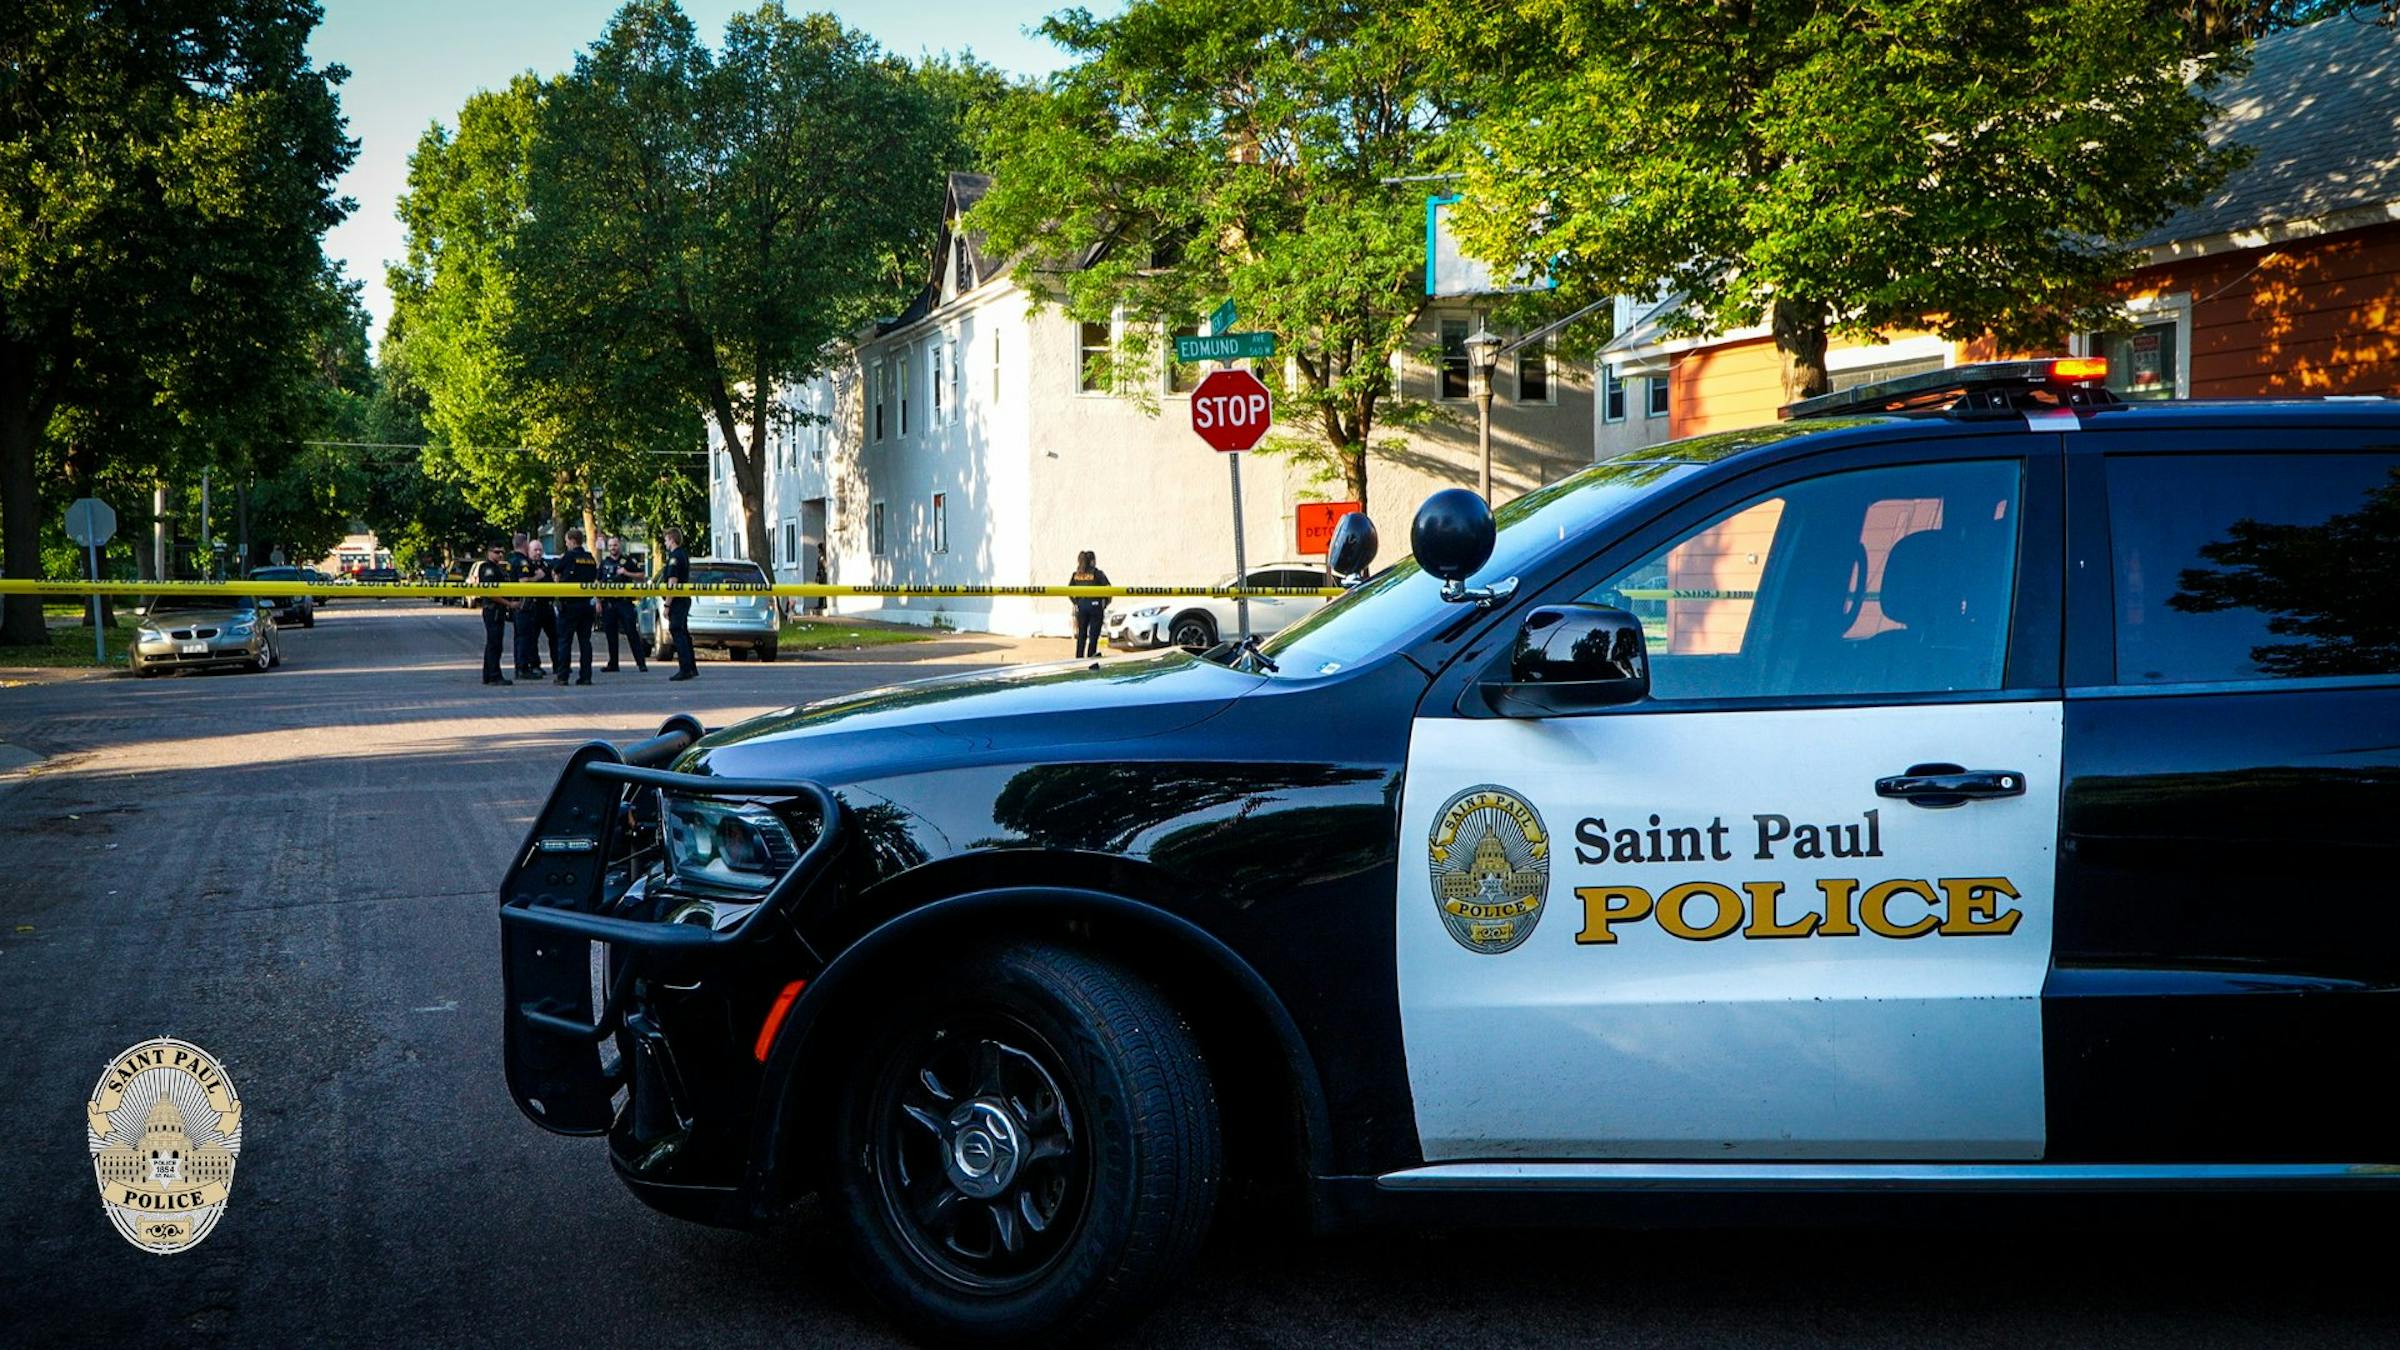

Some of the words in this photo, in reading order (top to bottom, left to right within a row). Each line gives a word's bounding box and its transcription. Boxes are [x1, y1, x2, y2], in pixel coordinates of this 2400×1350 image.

[1181, 339, 1239, 357] EDMUND
[1196, 394, 1266, 429] STOP
[1306, 527, 1335, 537] DETO
[1444, 795, 1487, 830] SAINT
[1496, 795, 1532, 828] PAUL
[1574, 814, 1732, 865] Saint
[1753, 809, 1884, 860] Paul
[1458, 900, 1526, 917] POLICE
[1574, 876, 2023, 946] POLICE
